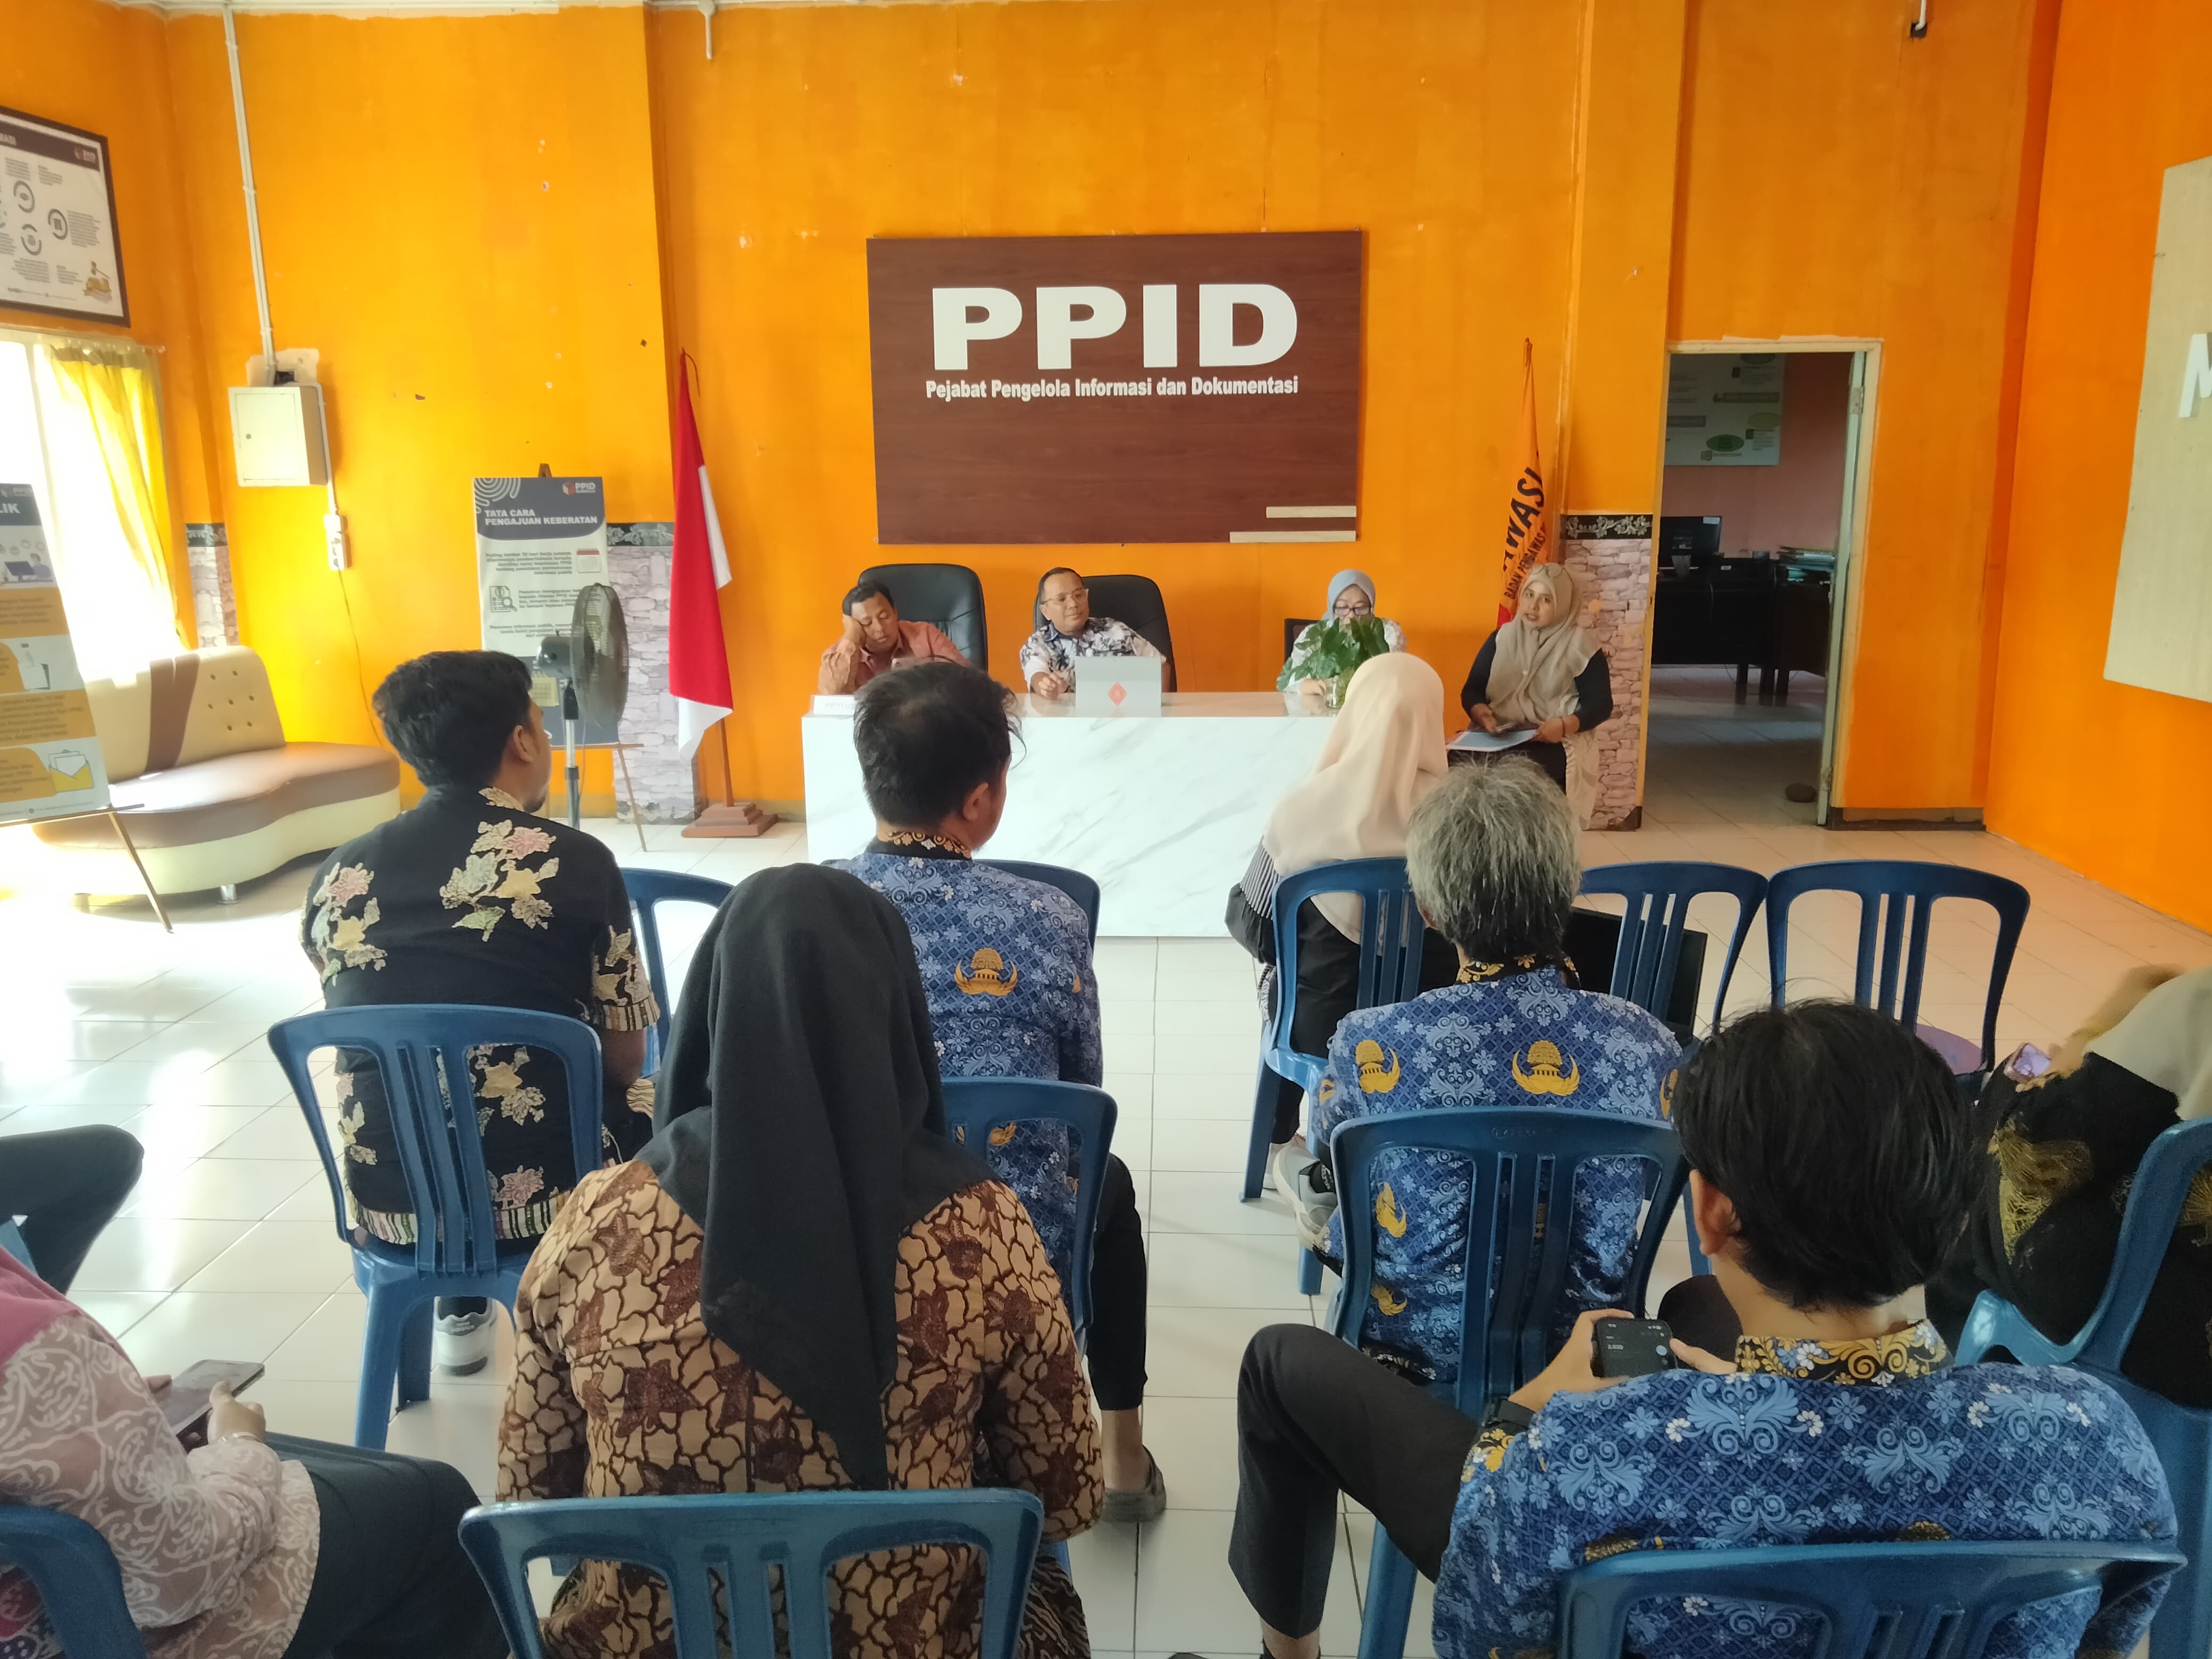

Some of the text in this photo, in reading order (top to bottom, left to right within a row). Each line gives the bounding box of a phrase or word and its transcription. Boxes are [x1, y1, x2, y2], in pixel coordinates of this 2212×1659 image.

[933, 284, 1297, 370] PPID
[926, 375, 1298, 402] Pejabat Pengelola Informasi dan Dokumentasi
[485, 516, 598, 525] PENGAJUAN KEBERATAN
[1504, 571, 1524, 600] BADAN
